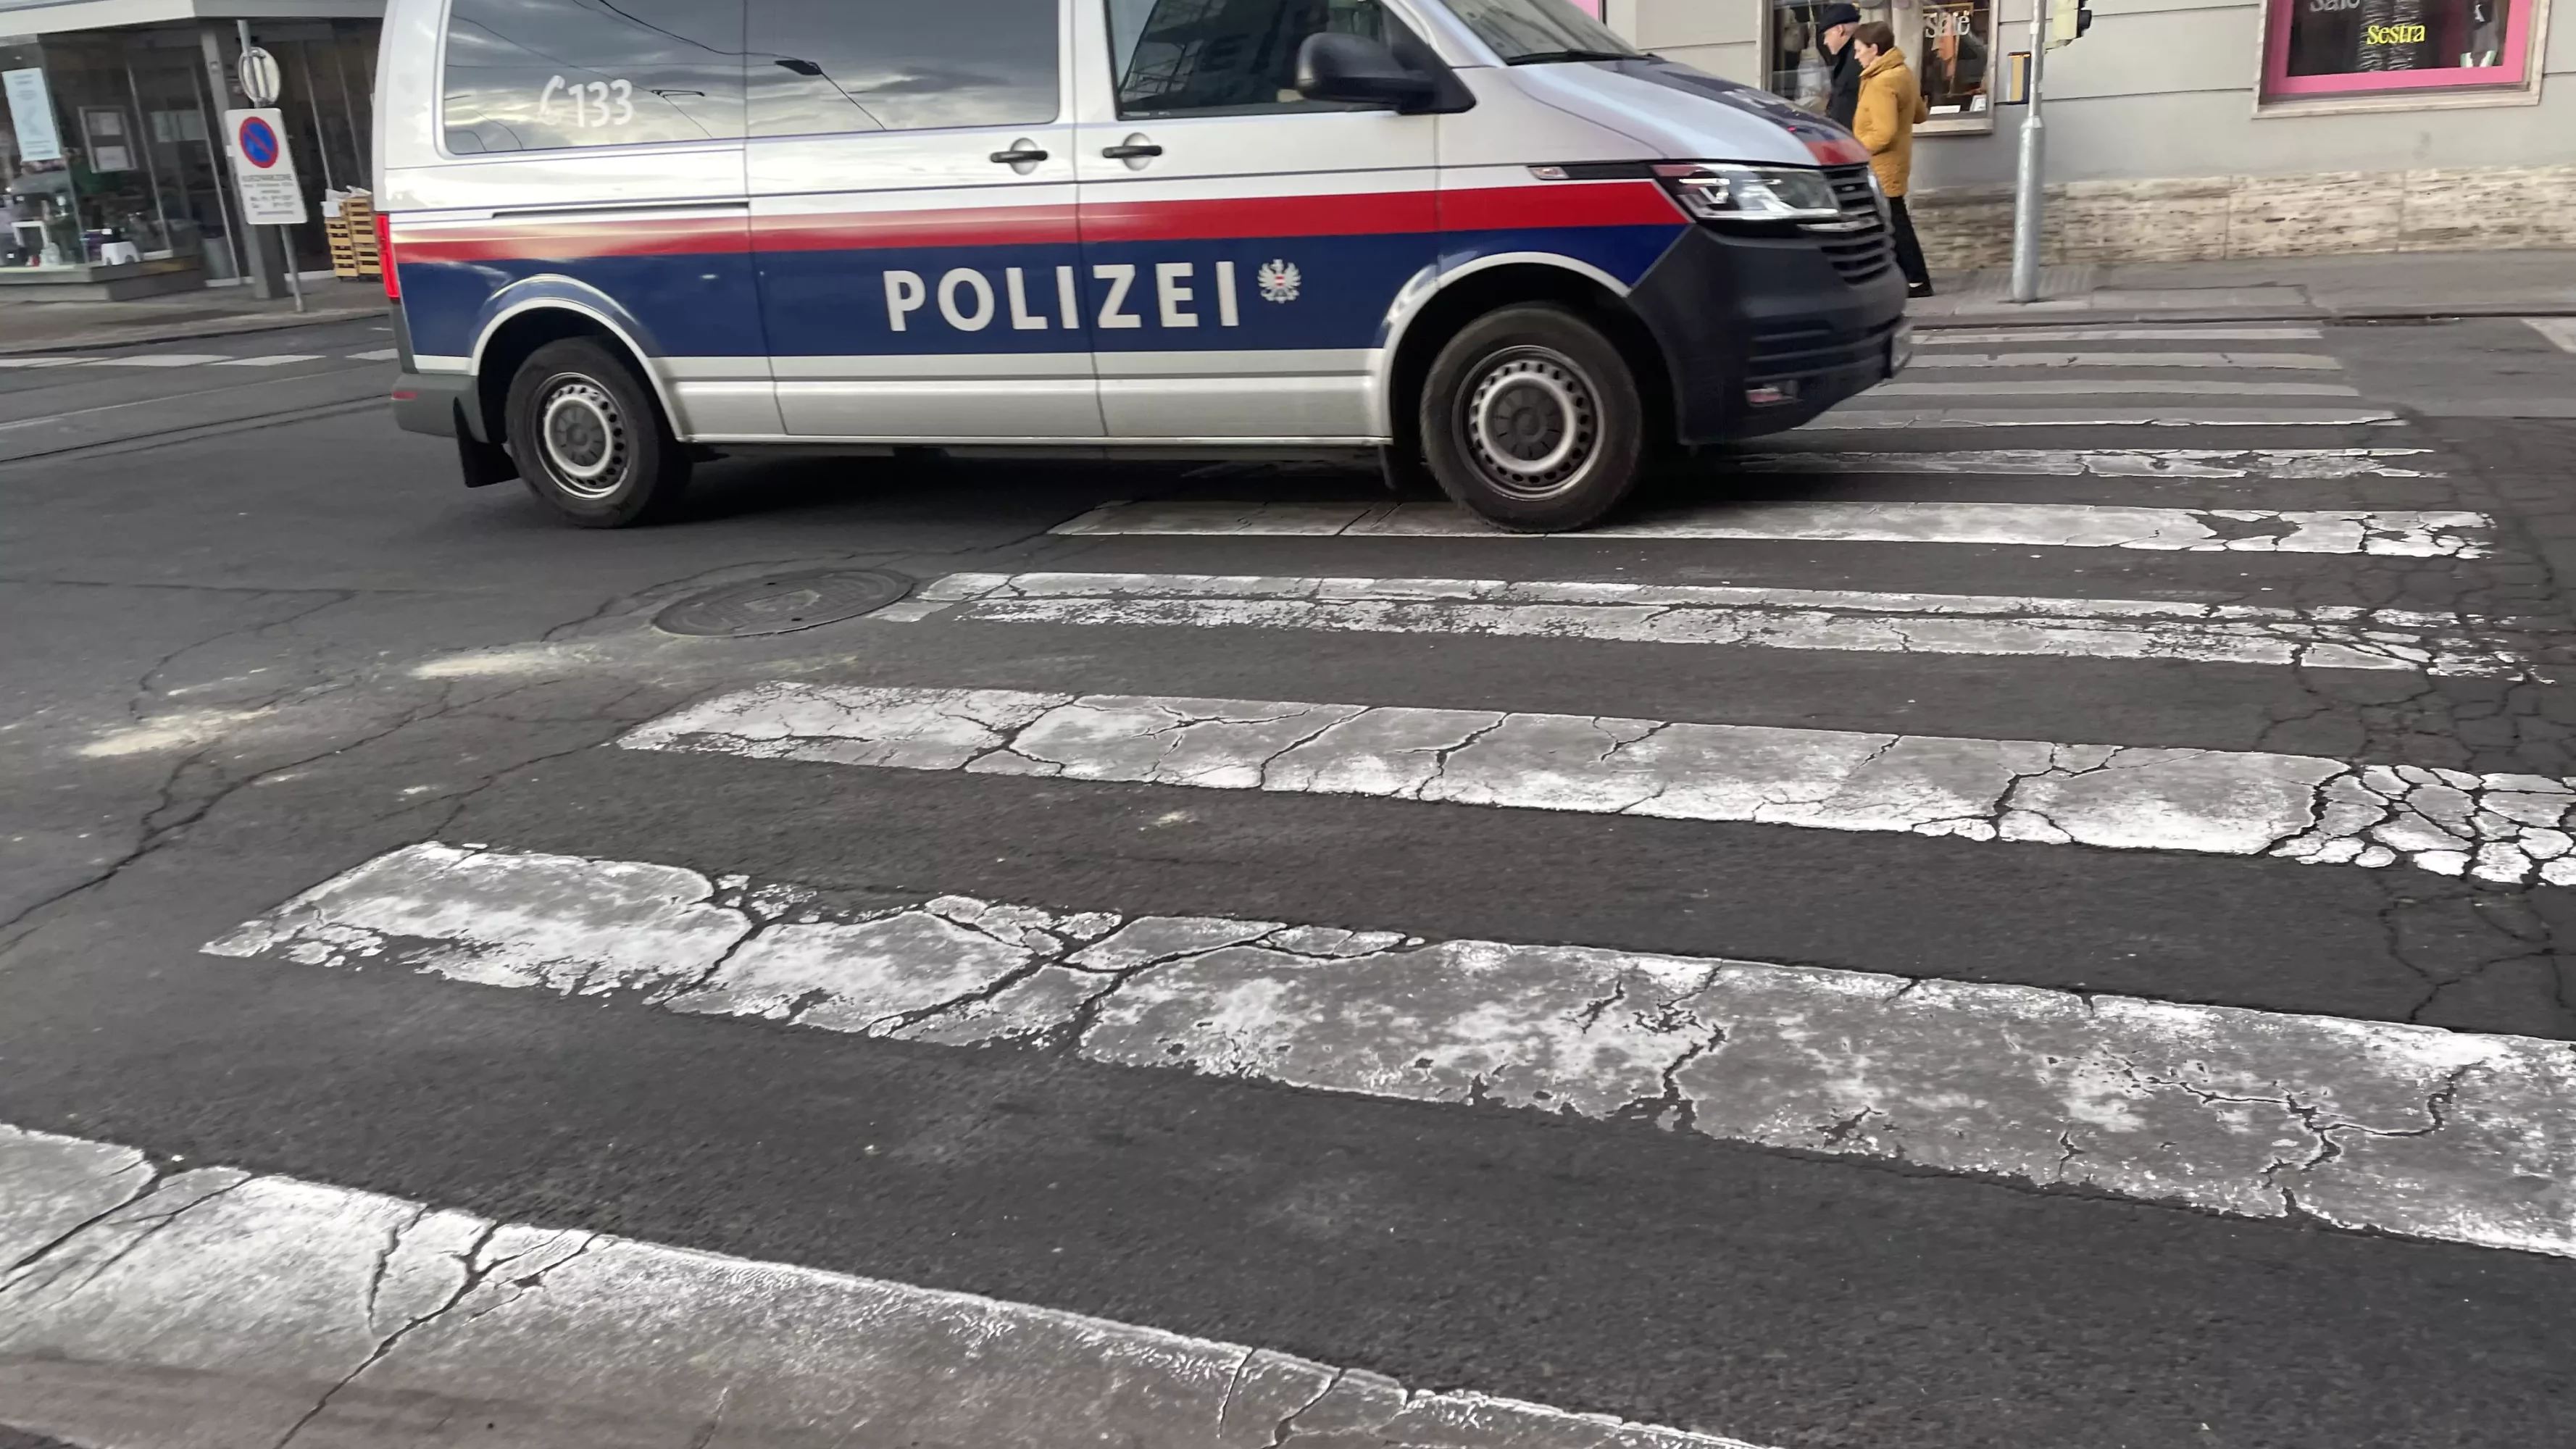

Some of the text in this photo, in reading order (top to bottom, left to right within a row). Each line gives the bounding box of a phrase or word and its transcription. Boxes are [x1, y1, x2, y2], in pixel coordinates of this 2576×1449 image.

[1924, 11, 1970, 38] Sale
[2367, 25, 2425, 45] Sestra
[568, 79, 633, 128] 133
[883, 262, 1239, 331] POLIZEI
